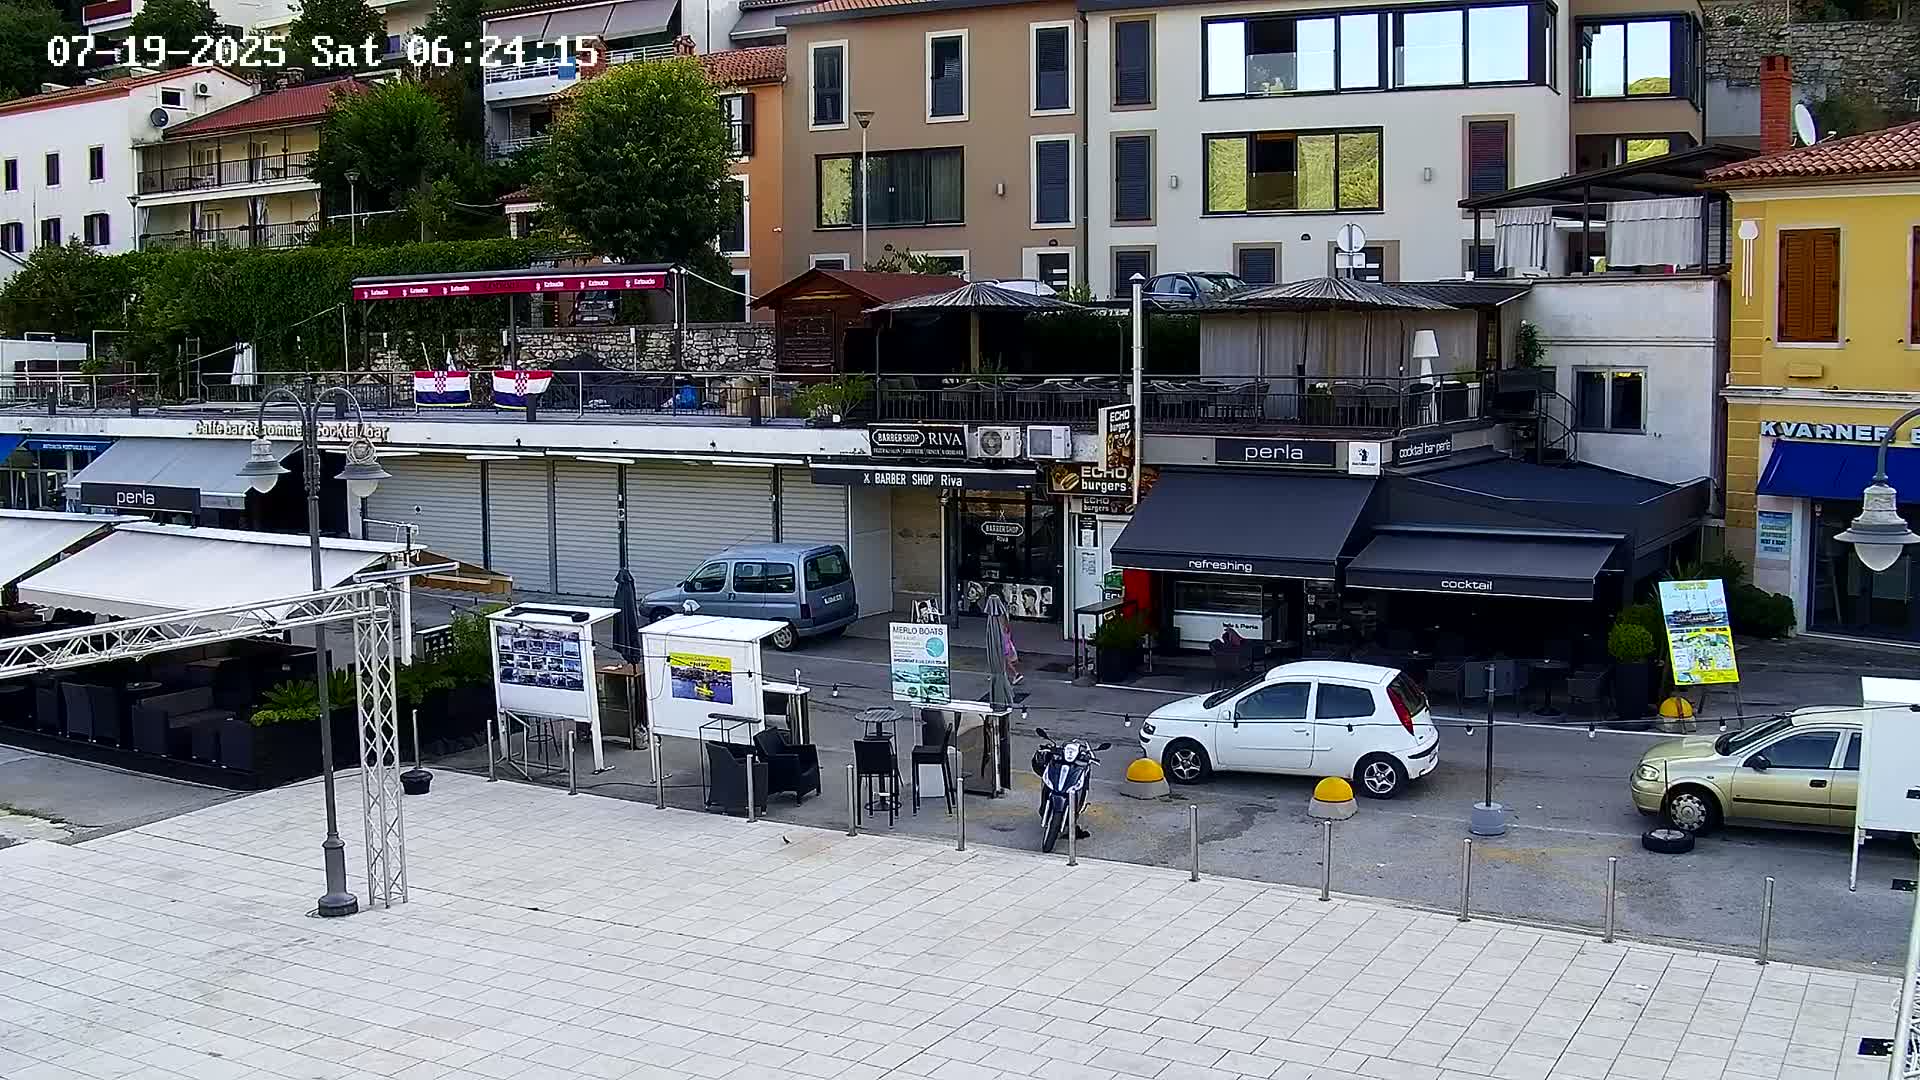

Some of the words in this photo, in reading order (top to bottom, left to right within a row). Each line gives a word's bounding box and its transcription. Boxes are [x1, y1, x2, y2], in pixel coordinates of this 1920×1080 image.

[1109, 409, 1130, 422] ECHO
[225, 420, 244, 435] bar
[1109, 422, 1130, 432] burgers
[928, 432, 963, 446] RIVA
[1244, 445, 1304, 462] perla
[1399, 443, 1423, 458] cocktail
[1424, 442, 1435, 454] bar
[1081, 466, 1127, 478] ECHO
[875, 472, 907, 485] BARBER
[911, 473, 934, 486] SHOP
[940, 474, 963, 487] Riva
[1081, 479, 1126, 493] burgers
[116, 489, 155, 505] perla
[1188, 560, 1253, 573] refreshing
[1441, 580, 1493, 591] cocktail
[892, 626, 918, 635] MERLO
[919, 627, 944, 636] BOATS
